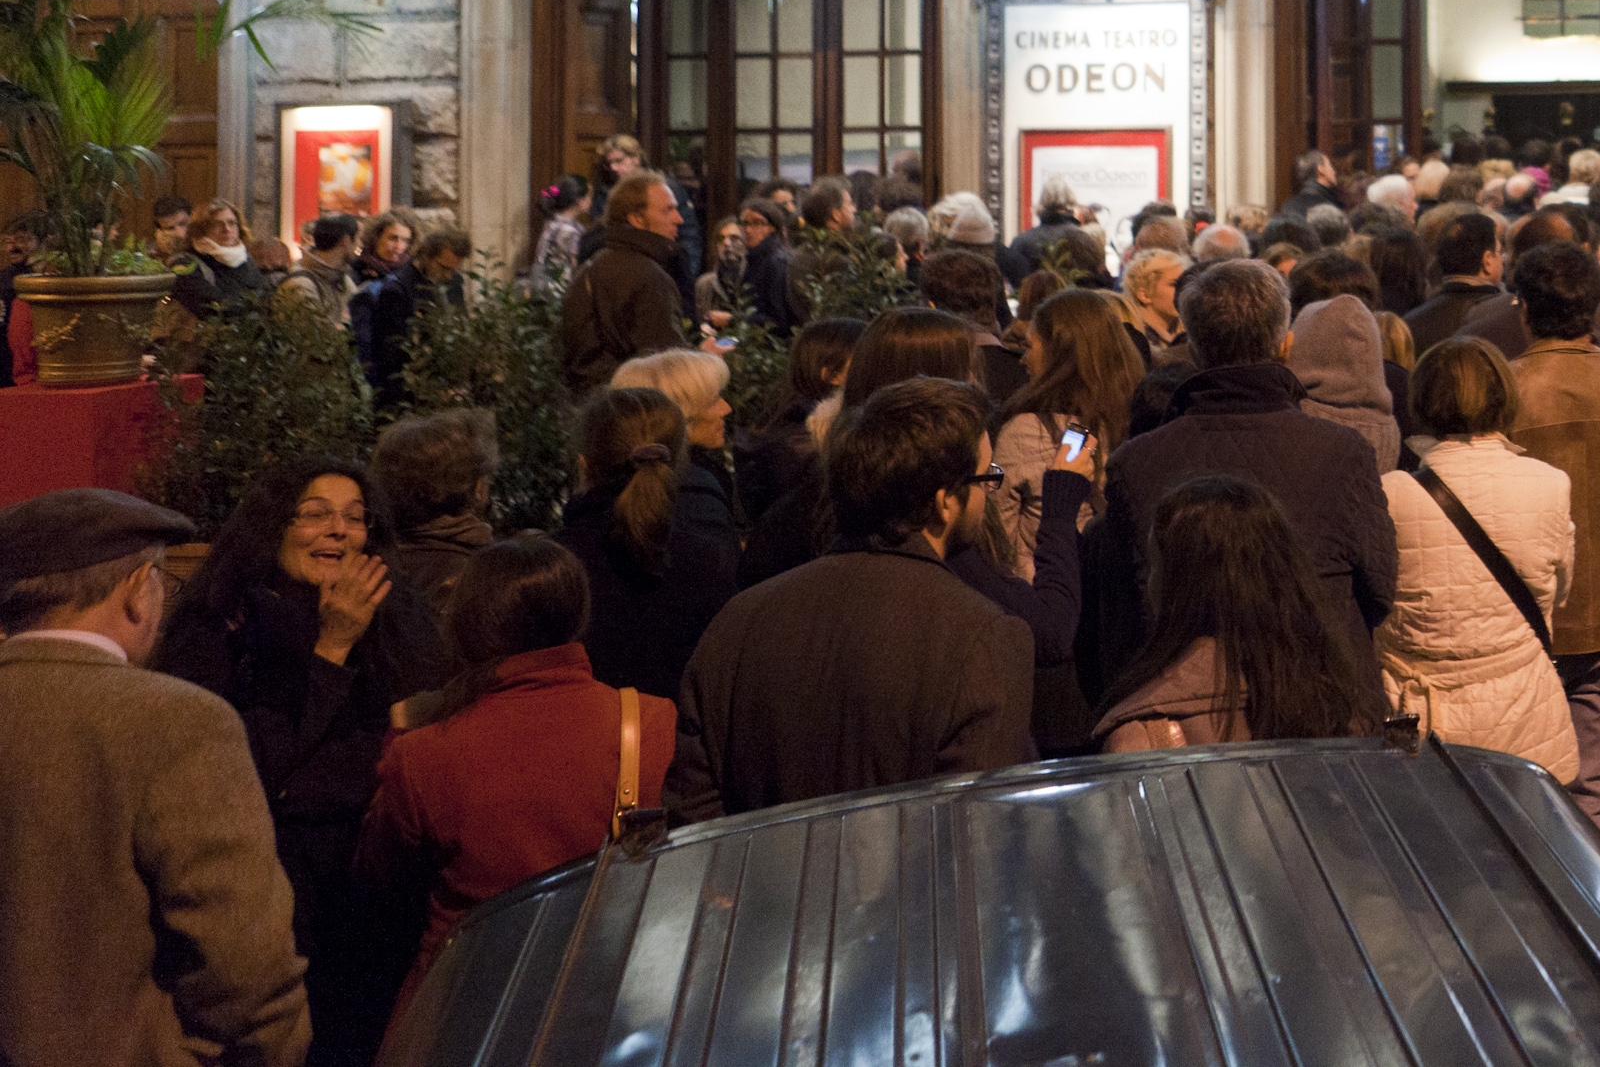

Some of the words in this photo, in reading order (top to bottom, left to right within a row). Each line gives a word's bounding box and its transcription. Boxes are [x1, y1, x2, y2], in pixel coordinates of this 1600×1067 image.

[1015, 30, 1091, 49] CINEMA
[1103, 29, 1178, 48] TEATRO
[1025, 63, 1166, 94] ODEON
[1095, 167, 1147, 182] Odeon
